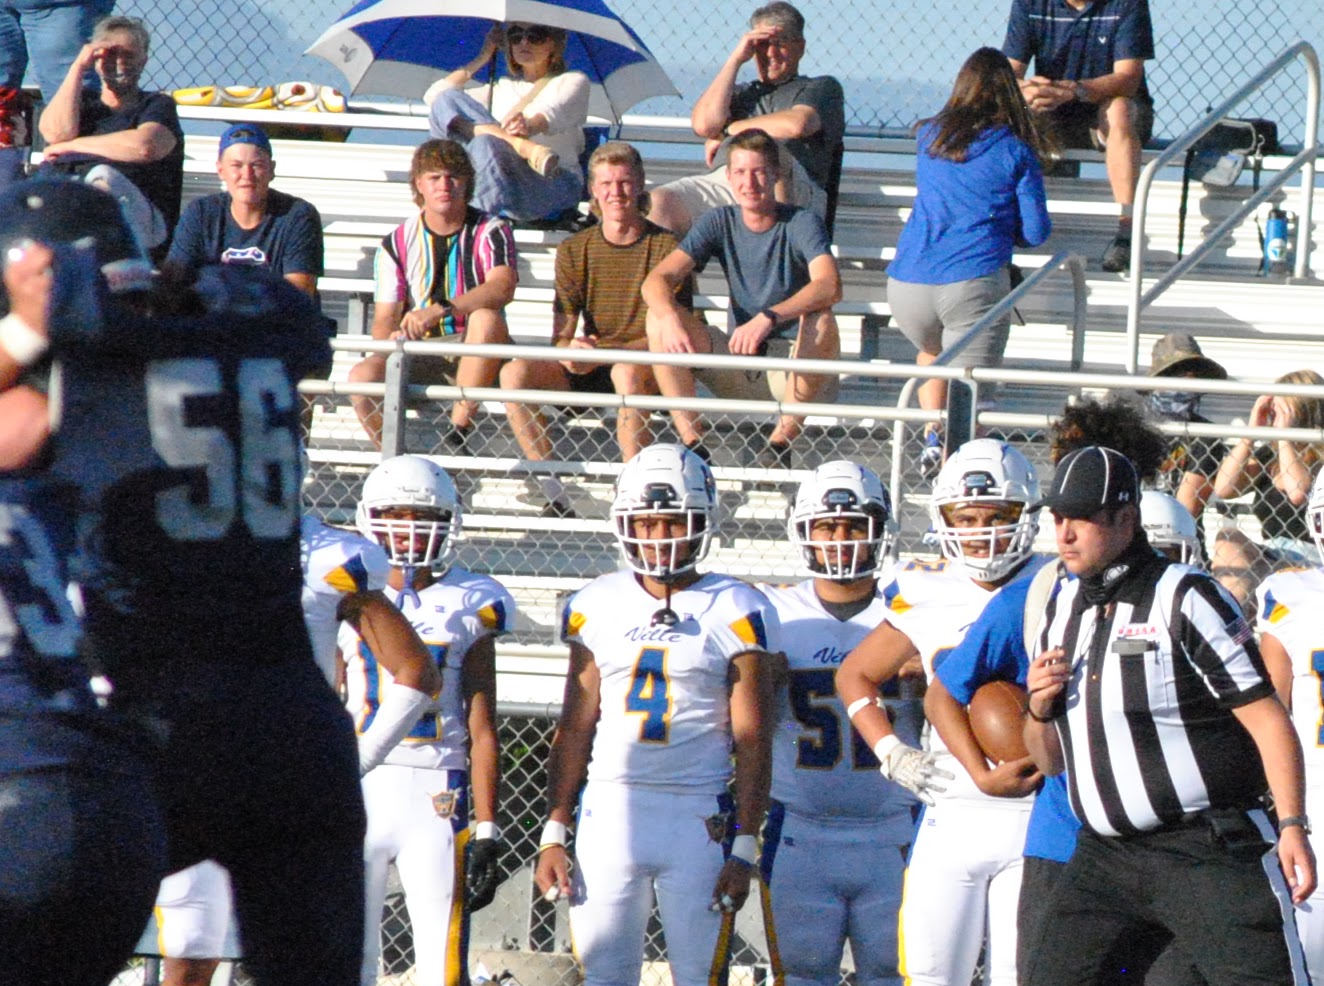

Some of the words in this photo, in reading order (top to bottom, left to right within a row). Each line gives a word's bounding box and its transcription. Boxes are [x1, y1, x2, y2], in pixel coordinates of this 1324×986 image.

[145, 357, 299, 541] 56
[624, 626, 682, 643] Ville
[624, 645, 674, 745] 4
